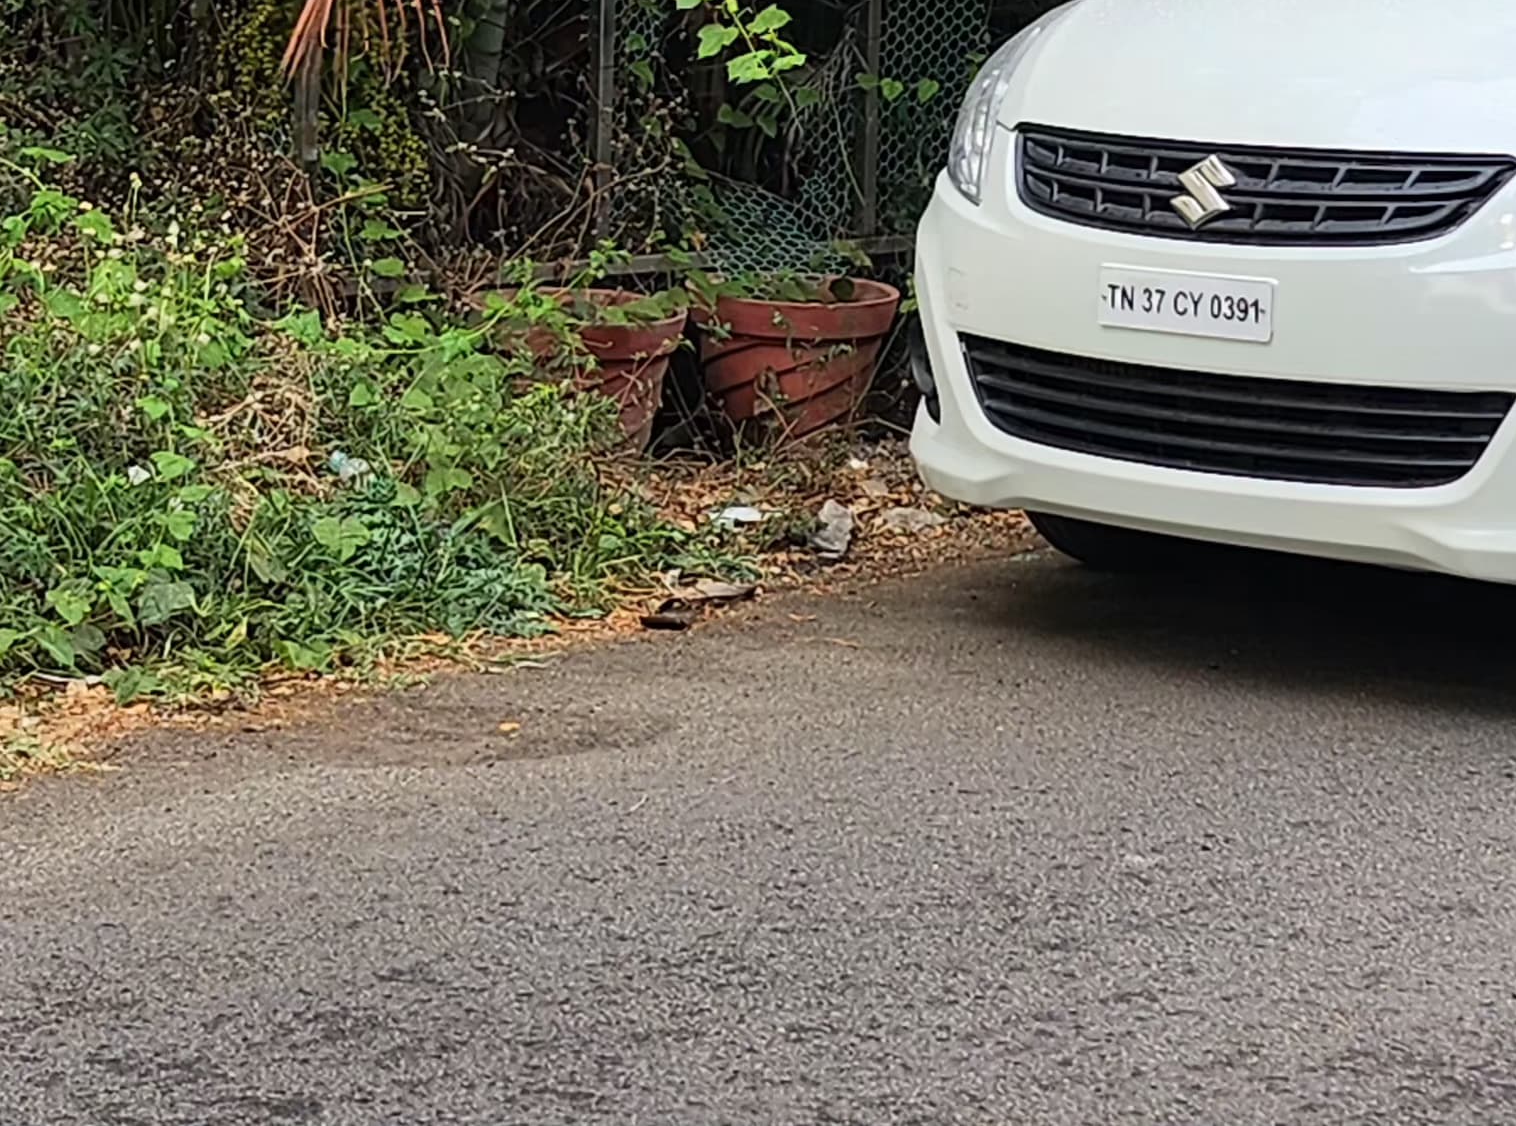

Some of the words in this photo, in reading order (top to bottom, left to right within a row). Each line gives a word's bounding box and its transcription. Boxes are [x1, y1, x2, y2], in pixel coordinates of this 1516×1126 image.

[1107, 283, 1134, 311] TN
[1142, 287, 1166, 314] 37
[1173, 290, 1204, 317] CY
[1210, 294, 1259, 324] 0391
